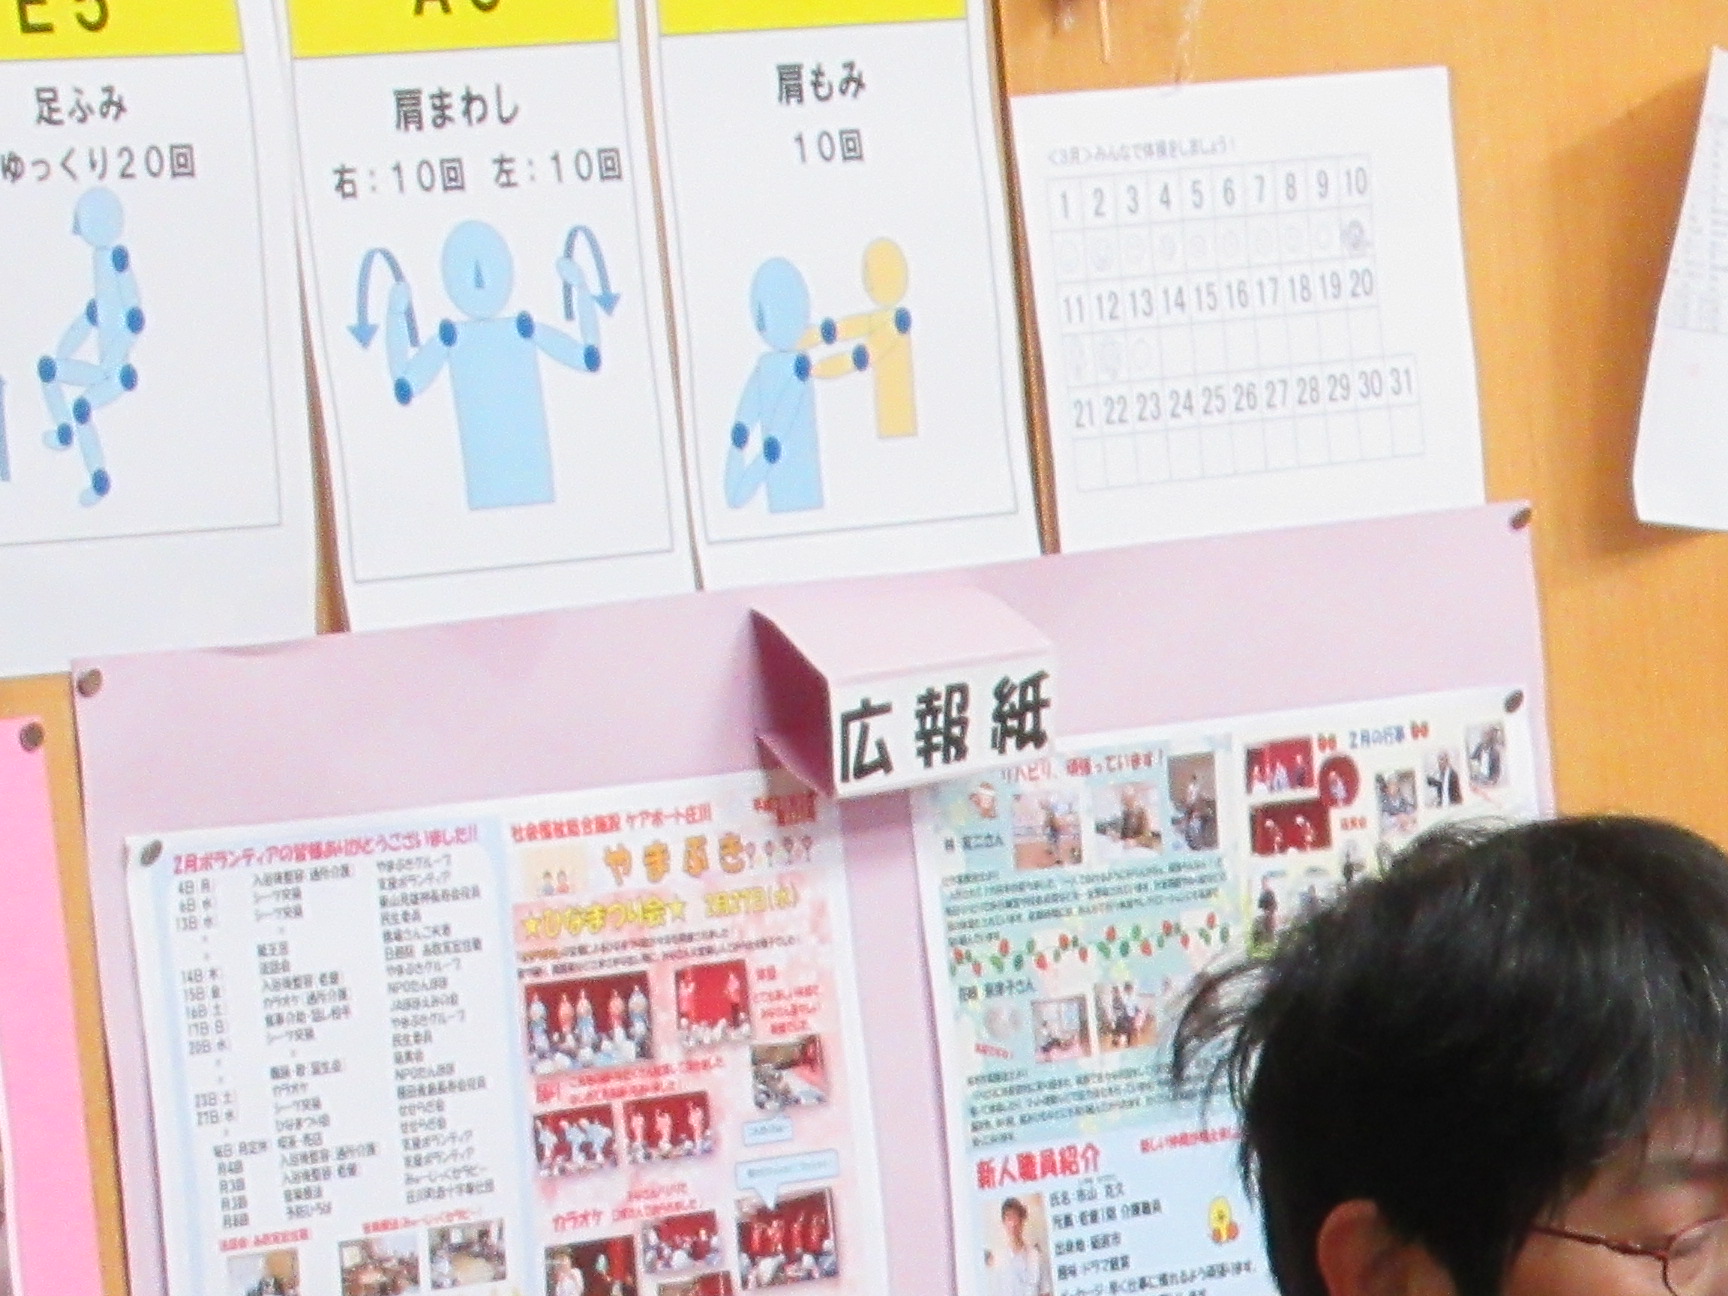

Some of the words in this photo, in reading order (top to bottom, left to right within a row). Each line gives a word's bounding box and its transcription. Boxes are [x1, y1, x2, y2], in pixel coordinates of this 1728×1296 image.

[35, 86, 127, 125] 足ふみ
[776, 61, 866, 105] 肩もみ
[393, 84, 518, 132] 肩まわし
[1, 144, 196, 184] ゆっくり20回
[794, 128, 864, 162] 10回
[1061, 191, 1070, 219] 1
[1094, 187, 1105, 217] 2
[1128, 186, 1139, 214] 3
[1159, 182, 1171, 210] 4
[1191, 180, 1203, 208] 5
[1223, 178, 1235, 207] 6
[1254, 175, 1266, 203] 7
[1285, 172, 1297, 201] 8
[1317, 170, 1329, 199] 9
[1346, 166, 1368, 196] 10
[1064, 296, 1084, 324] 11
[1096, 290, 1119, 321] 12
[1129, 288, 1153, 317] 13
[1162, 286, 1185, 314] 14
[1195, 282, 1217, 312] 15
[1226, 280, 1248, 309] 16
[1257, 277, 1279, 306] 17
[1288, 274, 1311, 303] 18
[1320, 271, 1342, 299] 19
[1350, 268, 1374, 298] 20
[1075, 399, 1095, 428] 21
[1105, 396, 1128, 425] 22
[1137, 392, 1161, 421] 23
[1170, 389, 1193, 418] 24
[1202, 386, 1226, 415] 25
[1234, 383, 1258, 412] 26
[1266, 378, 1288, 409] 27
[1297, 376, 1320, 406] 28
[1327, 373, 1350, 402] 29
[1359, 370, 1382, 399] 30
[1391, 367, 1412, 396] 31
[840, 669, 1051, 783] 広報紙
[604, 832, 745, 885] やまぶき
[976, 1142, 1101, 1190] 新人職員紹介
